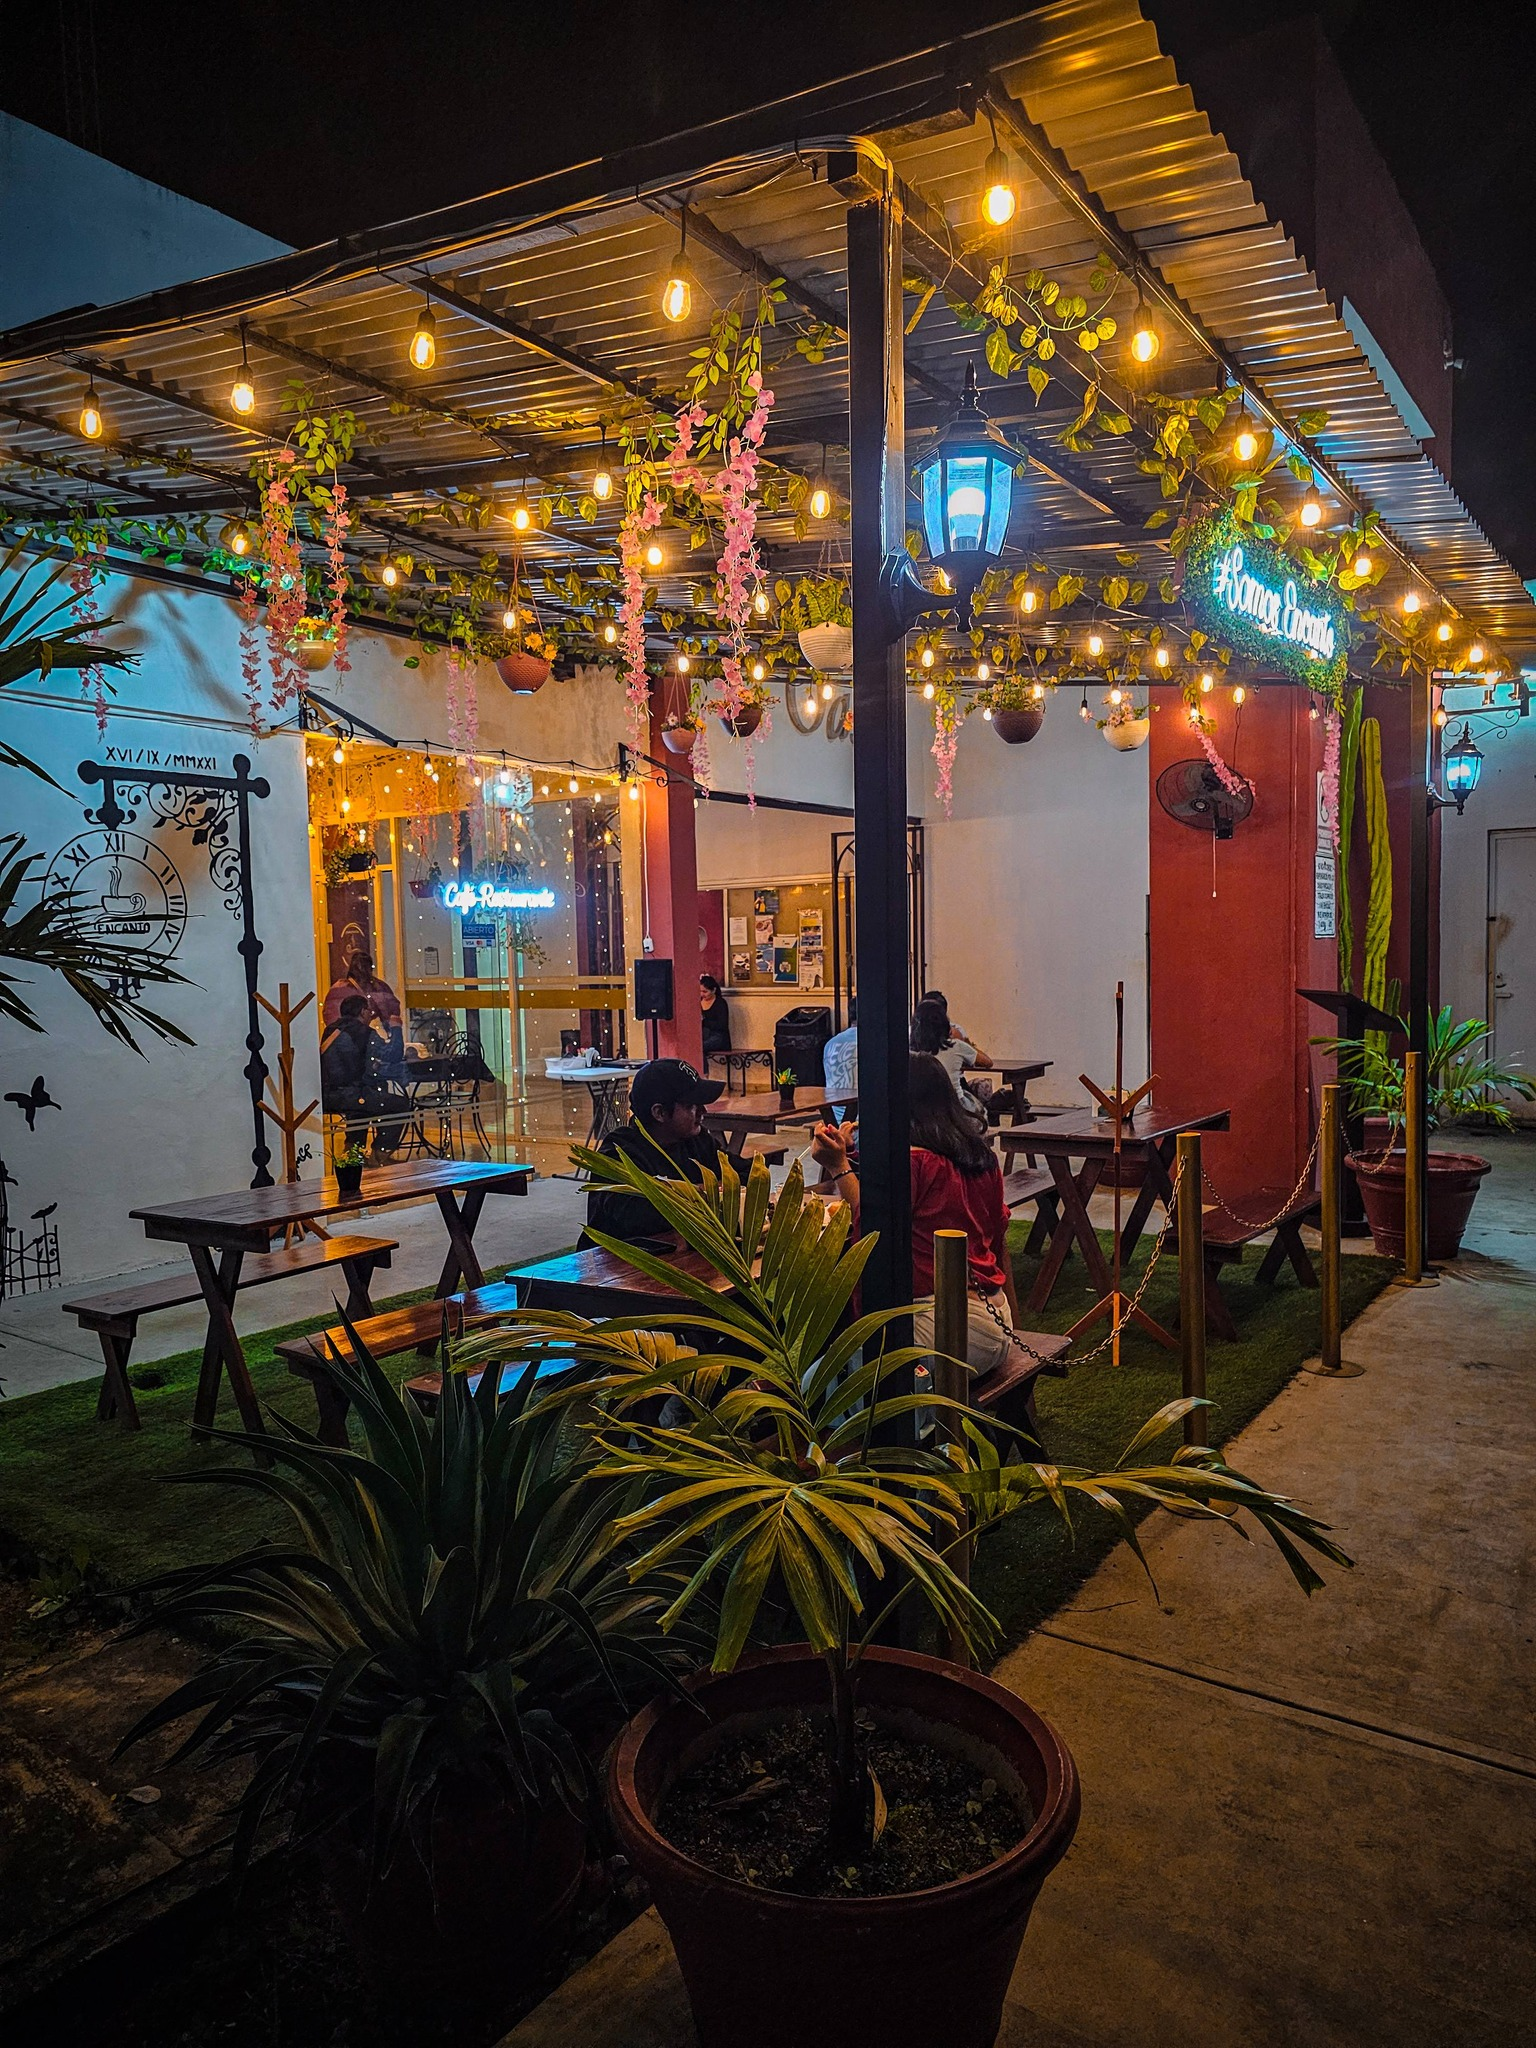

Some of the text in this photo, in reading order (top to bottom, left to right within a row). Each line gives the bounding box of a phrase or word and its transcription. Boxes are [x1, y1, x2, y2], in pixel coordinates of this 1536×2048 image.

[103, 833, 125, 853] XII
[64, 844, 90, 867] XI
[97, 921, 151, 935] ENCANTO
[463, 926, 495, 935] ABIERTO
